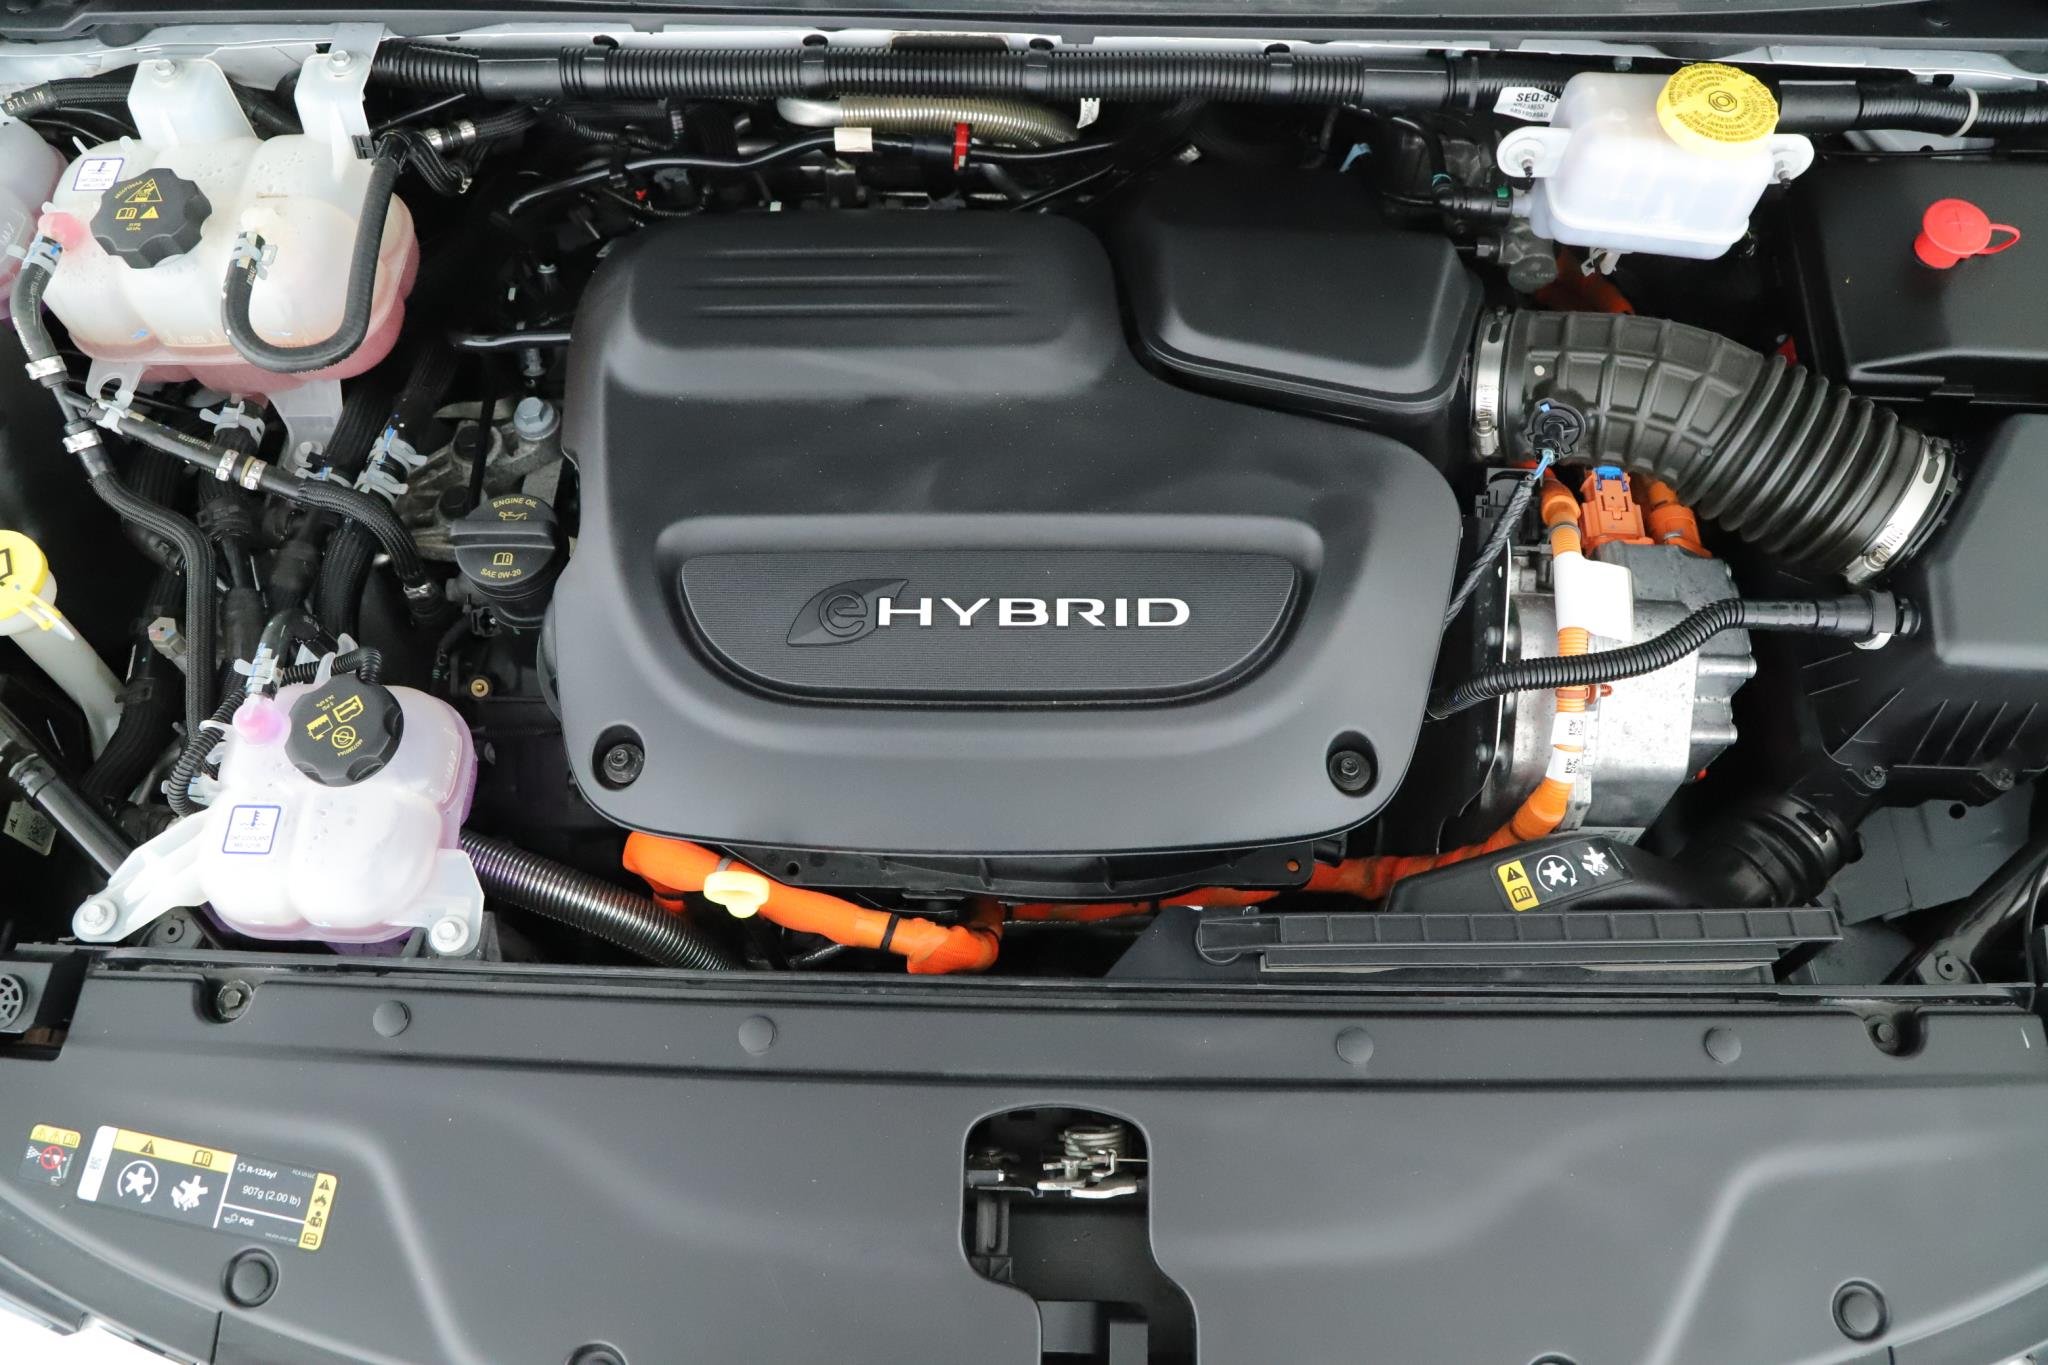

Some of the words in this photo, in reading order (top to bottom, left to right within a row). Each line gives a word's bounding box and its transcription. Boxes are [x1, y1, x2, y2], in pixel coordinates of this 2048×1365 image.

[492, 497, 525, 509] ENGINE
[524, 498, 538, 509] OIL
[480, 567, 497, 578] SAE
[497, 568, 522, 579] 0W-20
[246, 1165, 278, 1180] R-1234yf
[242, 1185, 264, 1200] 907g
[265, 1190, 288, 1203] (2.00
[289, 1195, 301, 1208] lb)
[239, 1216, 255, 1227] POE
